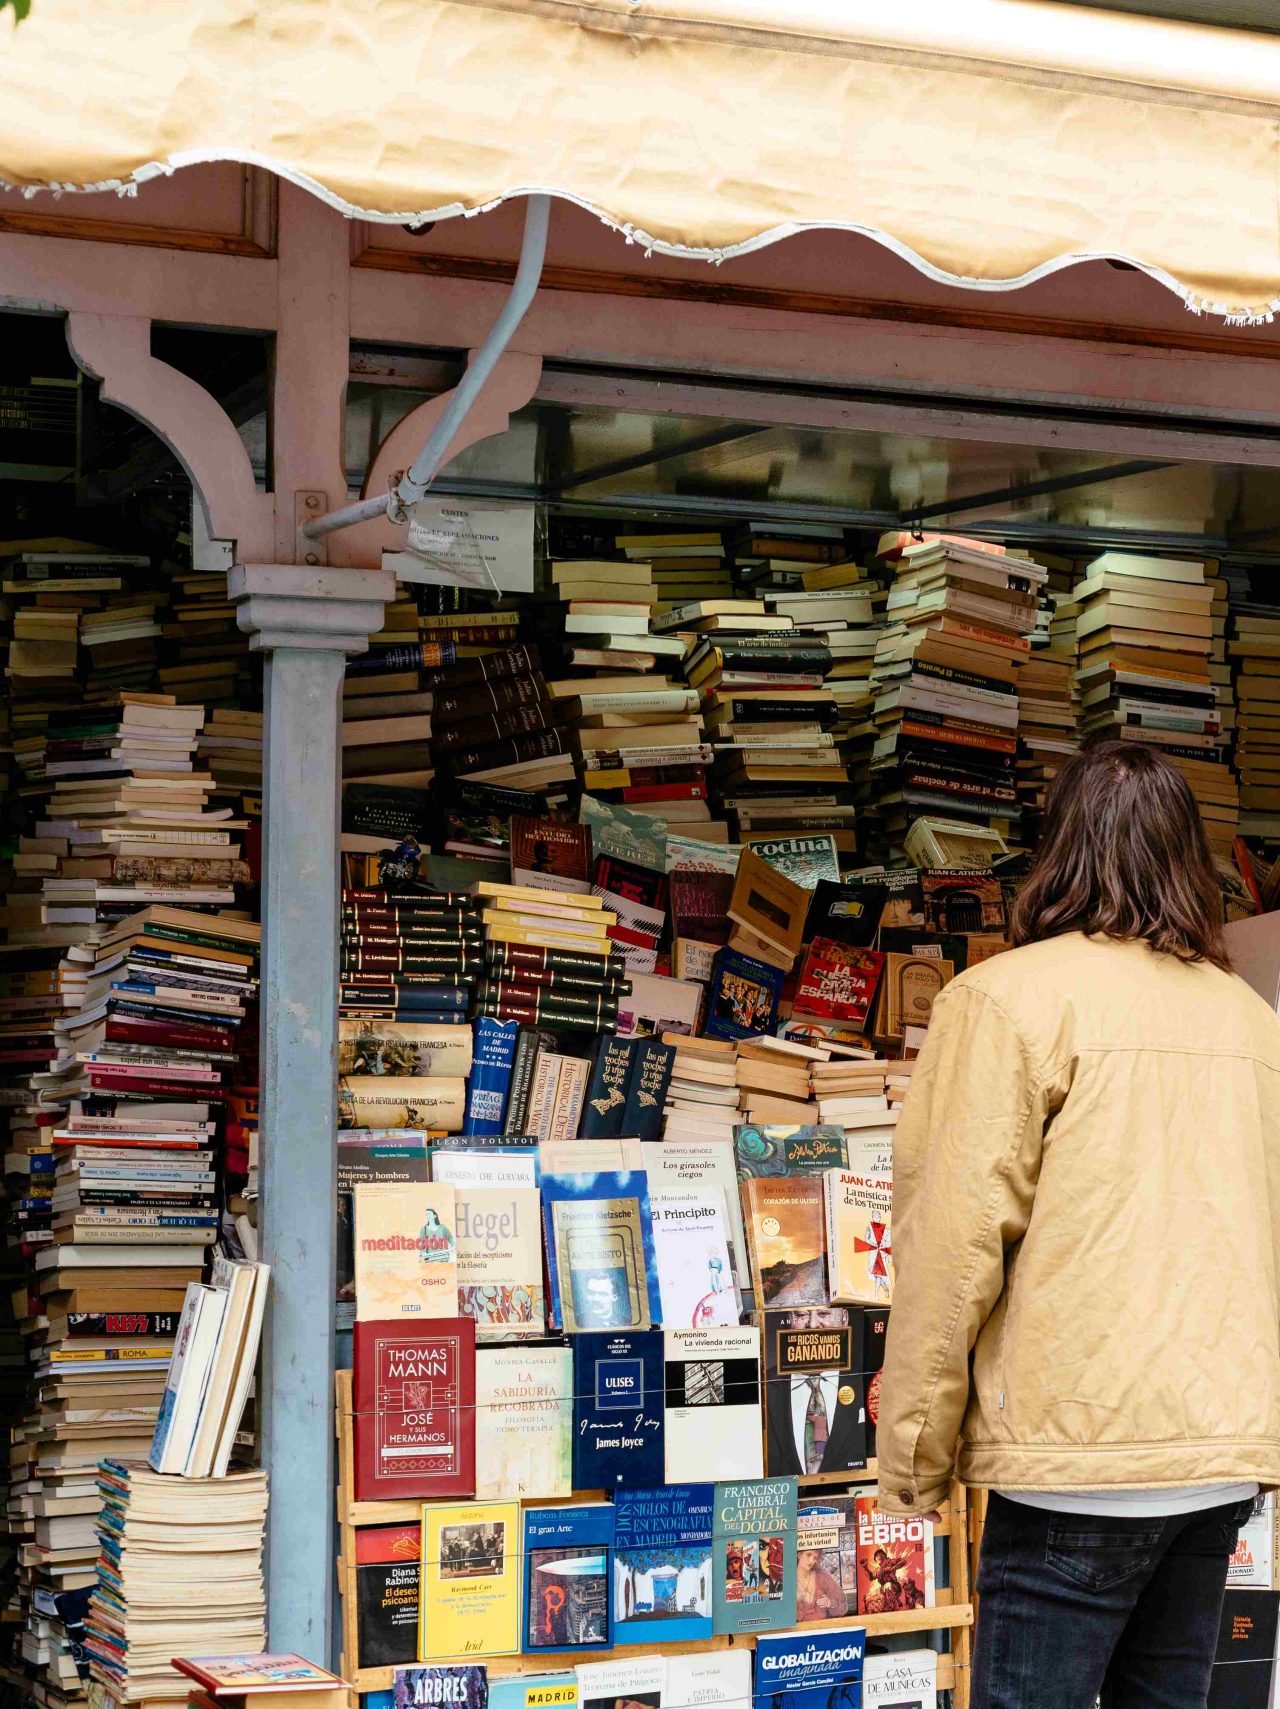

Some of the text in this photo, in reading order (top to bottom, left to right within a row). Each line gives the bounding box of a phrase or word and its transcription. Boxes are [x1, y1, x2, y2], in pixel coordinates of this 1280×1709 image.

[912, 775, 990, 795] el arte de cocinar
[750, 837, 831, 856] cocina
[493, 1032, 516, 1040] CALLES
[420, 1041, 447, 1049] FRANCESA
[482, 1045, 509, 1054] MADRID
[410, 1098, 437, 1106] FRANCESA
[437, 1137, 468, 1146] LEÓN
[877, 1155, 888, 1163] La
[663, 1161, 716, 1171] Los girasoles
[338, 1172, 367, 1180] Mujeres
[479, 1170, 529, 1182] CHE GUEVARA
[678, 1170, 703, 1179] ciegos
[840, 1174, 874, 1187] JUAN G.
[846, 1187, 856, 1196] La
[844, 1197, 866, 1207] de los
[651, 1207, 716, 1221] El Principito
[362, 1234, 449, 1251] meditación
[482, 1252, 512, 1260] escepticismo
[106, 1315, 149, 1332] KISS
[673, 1331, 707, 1340] Aymonino
[787, 1334, 840, 1344] LOS RICOS VAMOS
[684, 1339, 692, 1347] La
[123, 1350, 147, 1358] ROMA
[388, 1348, 447, 1362] THOMAS
[787, 1344, 841, 1361] GANANDO
[388, 1362, 447, 1377] MANN
[518, 1373, 533, 1383] LA
[605, 1377, 634, 1388] ULISES
[493, 1385, 556, 1397] SABIDURÍA
[490, 1400, 561, 1413] RECOBRADA
[401, 1411, 434, 1426] JOSÉ
[389, 1433, 446, 1444] HERMANOS
[596, 1437, 644, 1449] James Joyce
[724, 1483, 790, 1499] FRANCISCO
[736, 1494, 787, 1508] UMBRAL
[633, 1501, 686, 1516] SIGLOS DE
[721, 1506, 783, 1521] CAPITAL
[858, 1511, 868, 1524] la
[528, 1524, 573, 1535] El gran Arte
[724, 1518, 788, 1534] DEL DOLOR
[805, 1531, 837, 1539] infortunios
[859, 1522, 923, 1546] EBRO
[392, 1568, 416, 1577] Diana
[385, 1588, 417, 1597] El deseo
[762, 1645, 862, 1670] GLOBALIZACIÓN
[778, 1662, 841, 1679] imaginada
[886, 1669, 912, 1679] CASA
[414, 1676, 467, 1704] ARBRES
[868, 1684, 882, 1694] DE
[528, 1692, 575, 1704] MADRID
